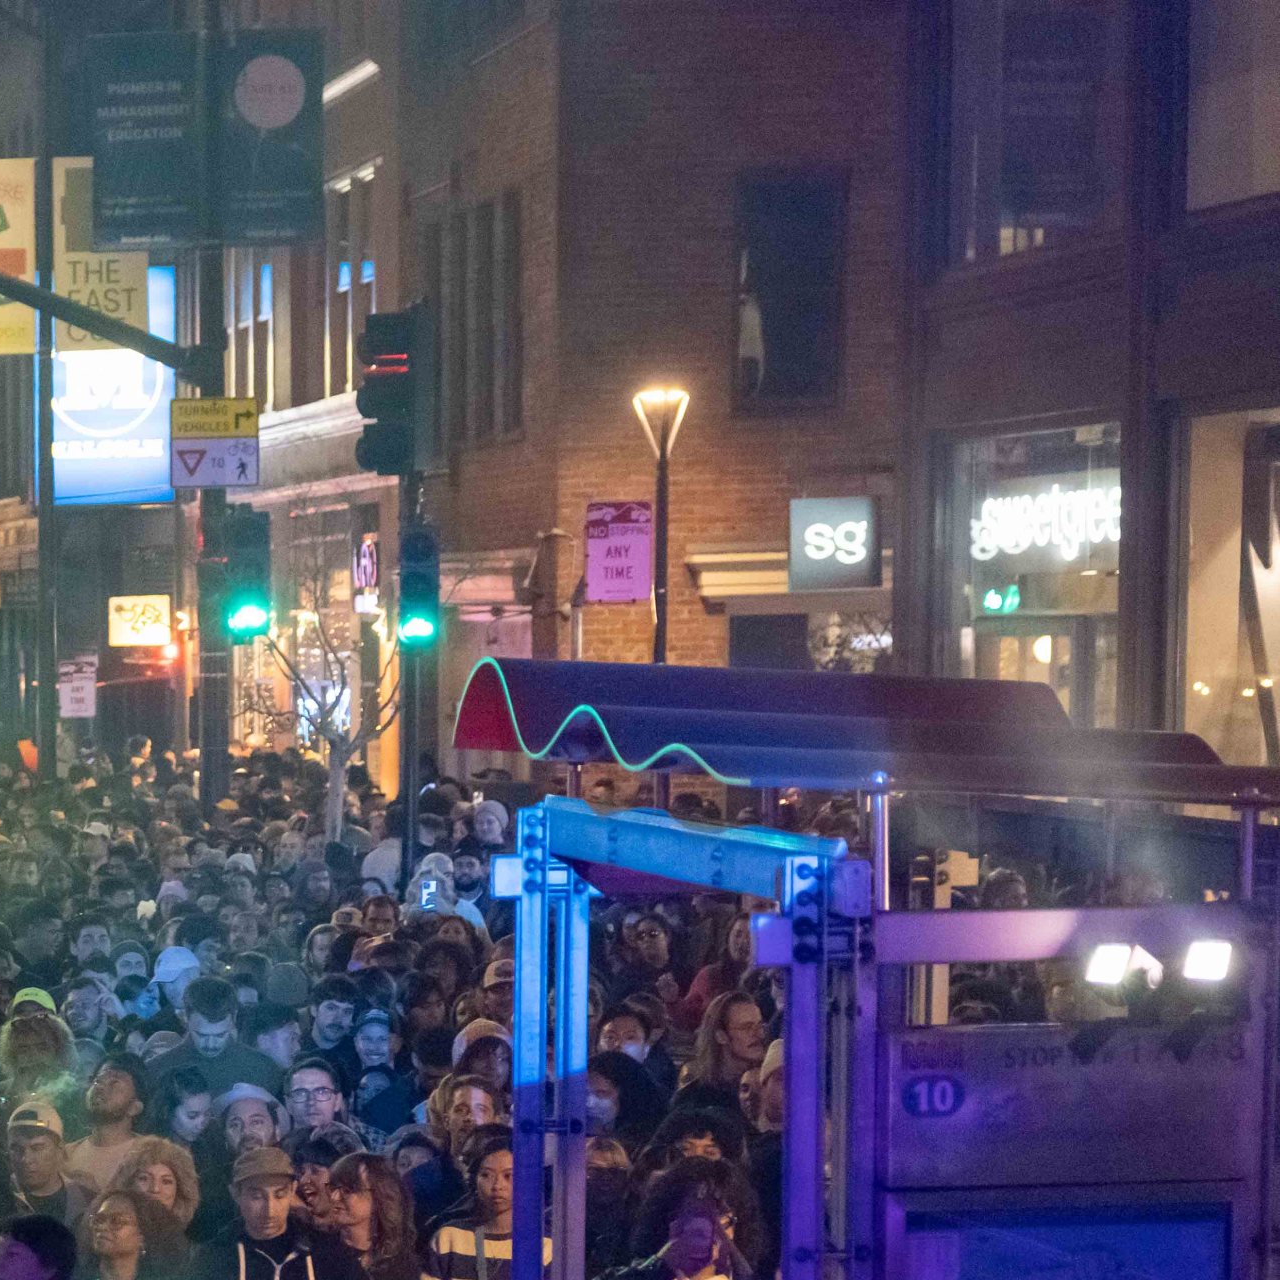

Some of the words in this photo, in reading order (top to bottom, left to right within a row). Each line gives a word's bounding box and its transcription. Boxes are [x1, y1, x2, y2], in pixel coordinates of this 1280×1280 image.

[96, 104, 190, 118] MANAGEMENT
[106, 127, 183, 141] EDUCATION
[67, 259, 121, 284] THE
[177, 404, 229, 417] TURNING
[177, 421, 231, 433] VEHICLES
[210, 457, 225, 469] TO
[588, 526, 608, 537] NO
[609, 525, 650, 537] STOPPING
[803, 520, 868, 564] sg
[605, 543, 631, 558] ANY
[603, 566, 634, 579] TIME
[914, 1079, 955, 1113] 10
